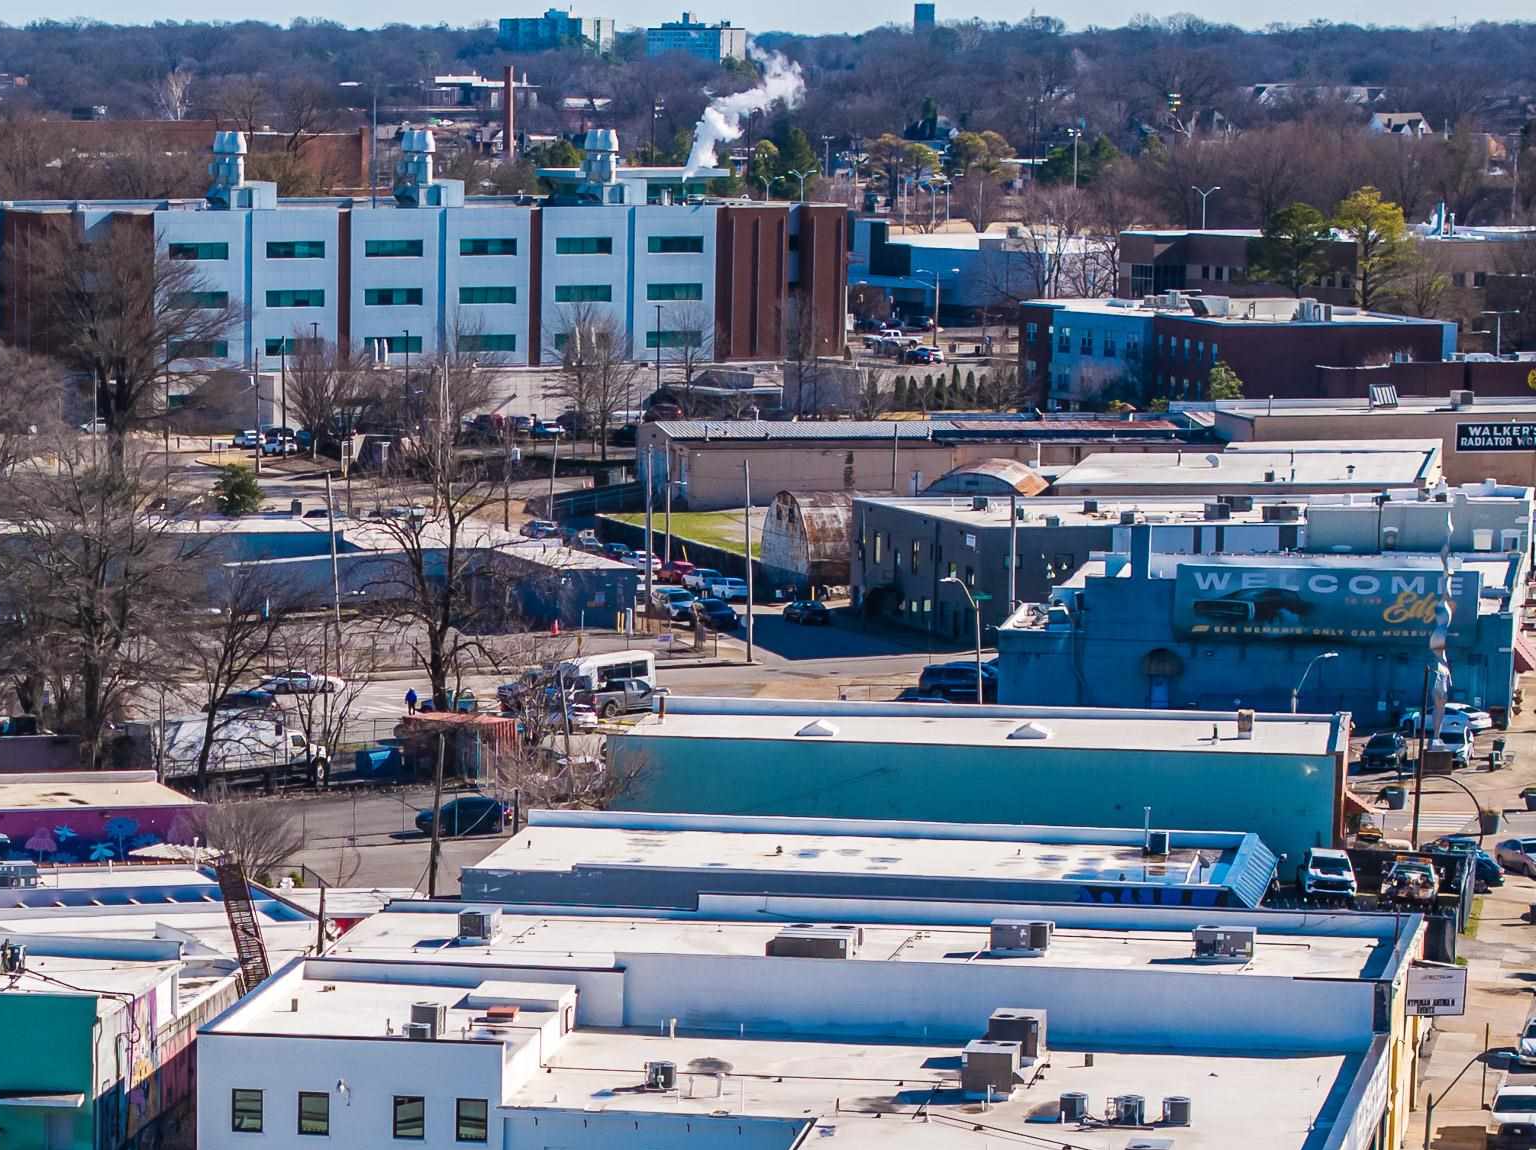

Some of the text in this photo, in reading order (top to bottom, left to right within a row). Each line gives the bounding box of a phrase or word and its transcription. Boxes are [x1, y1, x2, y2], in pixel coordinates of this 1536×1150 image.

[1460, 437, 1513, 446] RADIATOR
[1193, 572, 1463, 595] WELCOME
[1382, 629, 1435, 637] MUSEU
